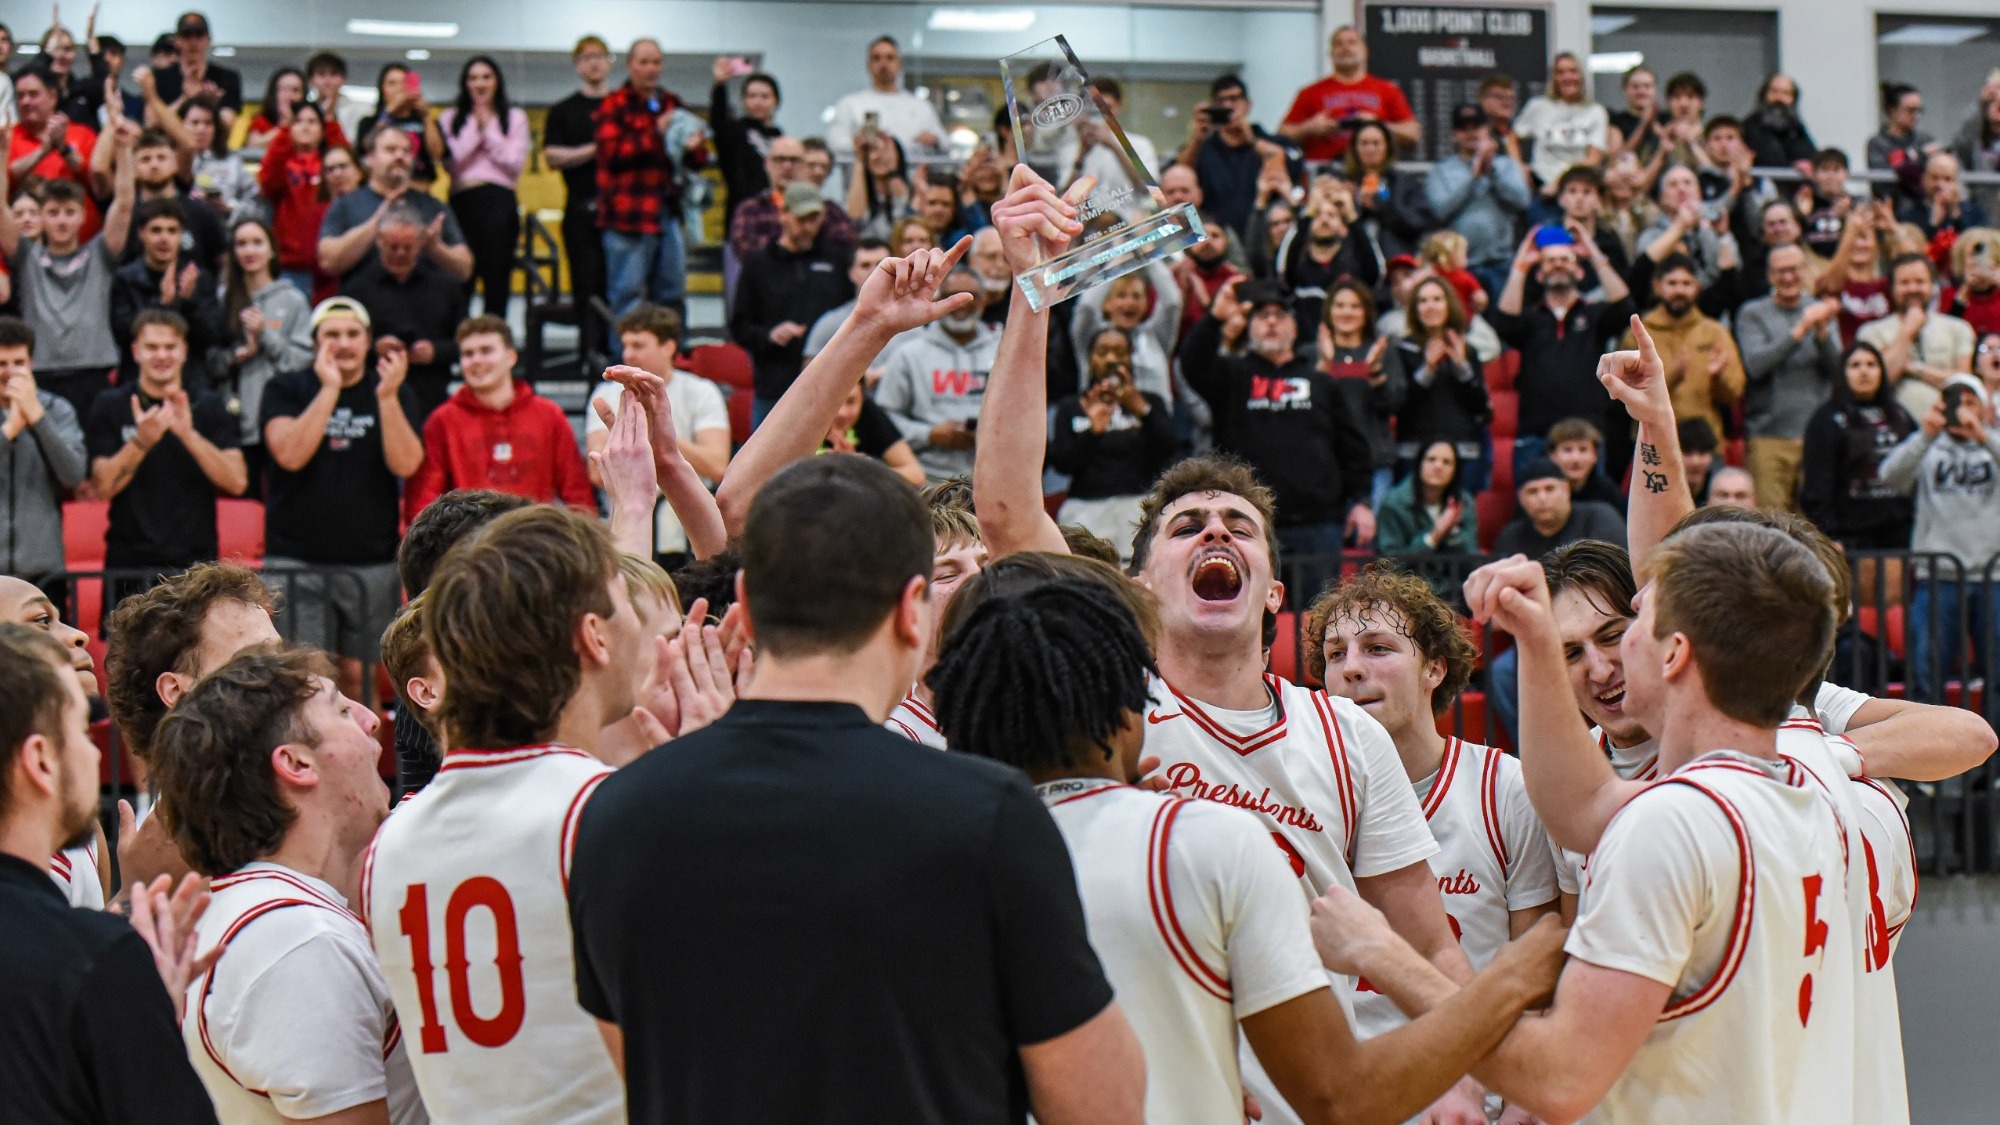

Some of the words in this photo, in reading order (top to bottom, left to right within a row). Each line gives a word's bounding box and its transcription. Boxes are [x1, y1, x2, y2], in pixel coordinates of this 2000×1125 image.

[1381, 8, 1432, 34] 1,000
[1436, 10, 1484, 34] POINT
[1488, 12, 1532, 35] CLUB
[1419, 47, 1497, 67] BASKETBALL
[1049, 781, 1084, 794] PRO
[399, 876, 525, 1054] 10
